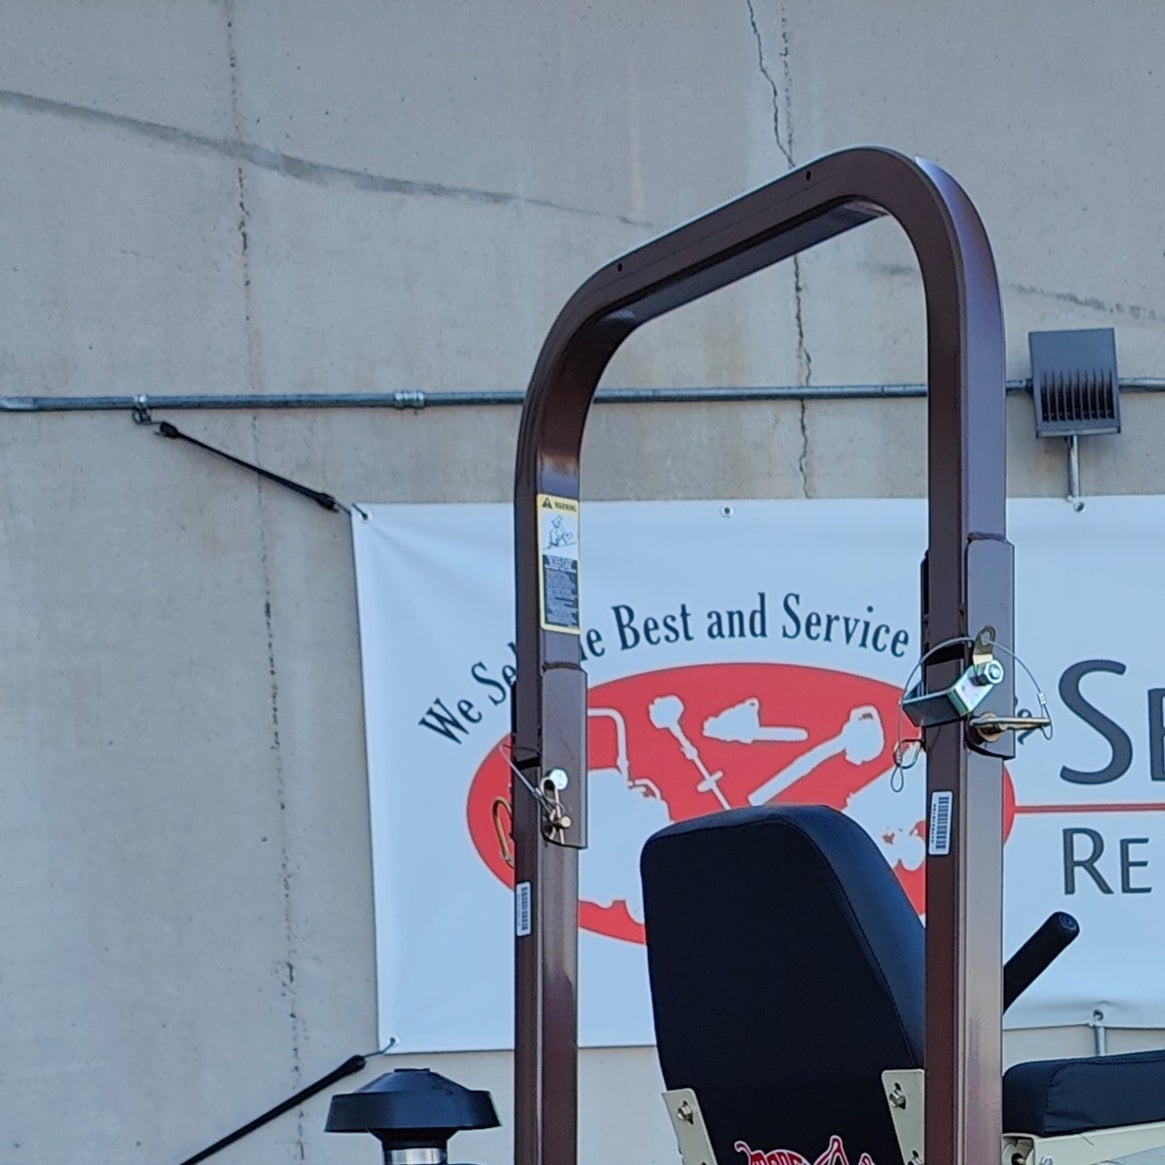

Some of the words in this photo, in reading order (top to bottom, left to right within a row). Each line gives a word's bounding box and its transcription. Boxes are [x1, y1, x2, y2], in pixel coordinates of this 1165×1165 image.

[418, 697, 483, 745] We
[611, 603, 694, 651] Best
[707, 594, 767, 640] and
[781, 593, 910, 658] Service
